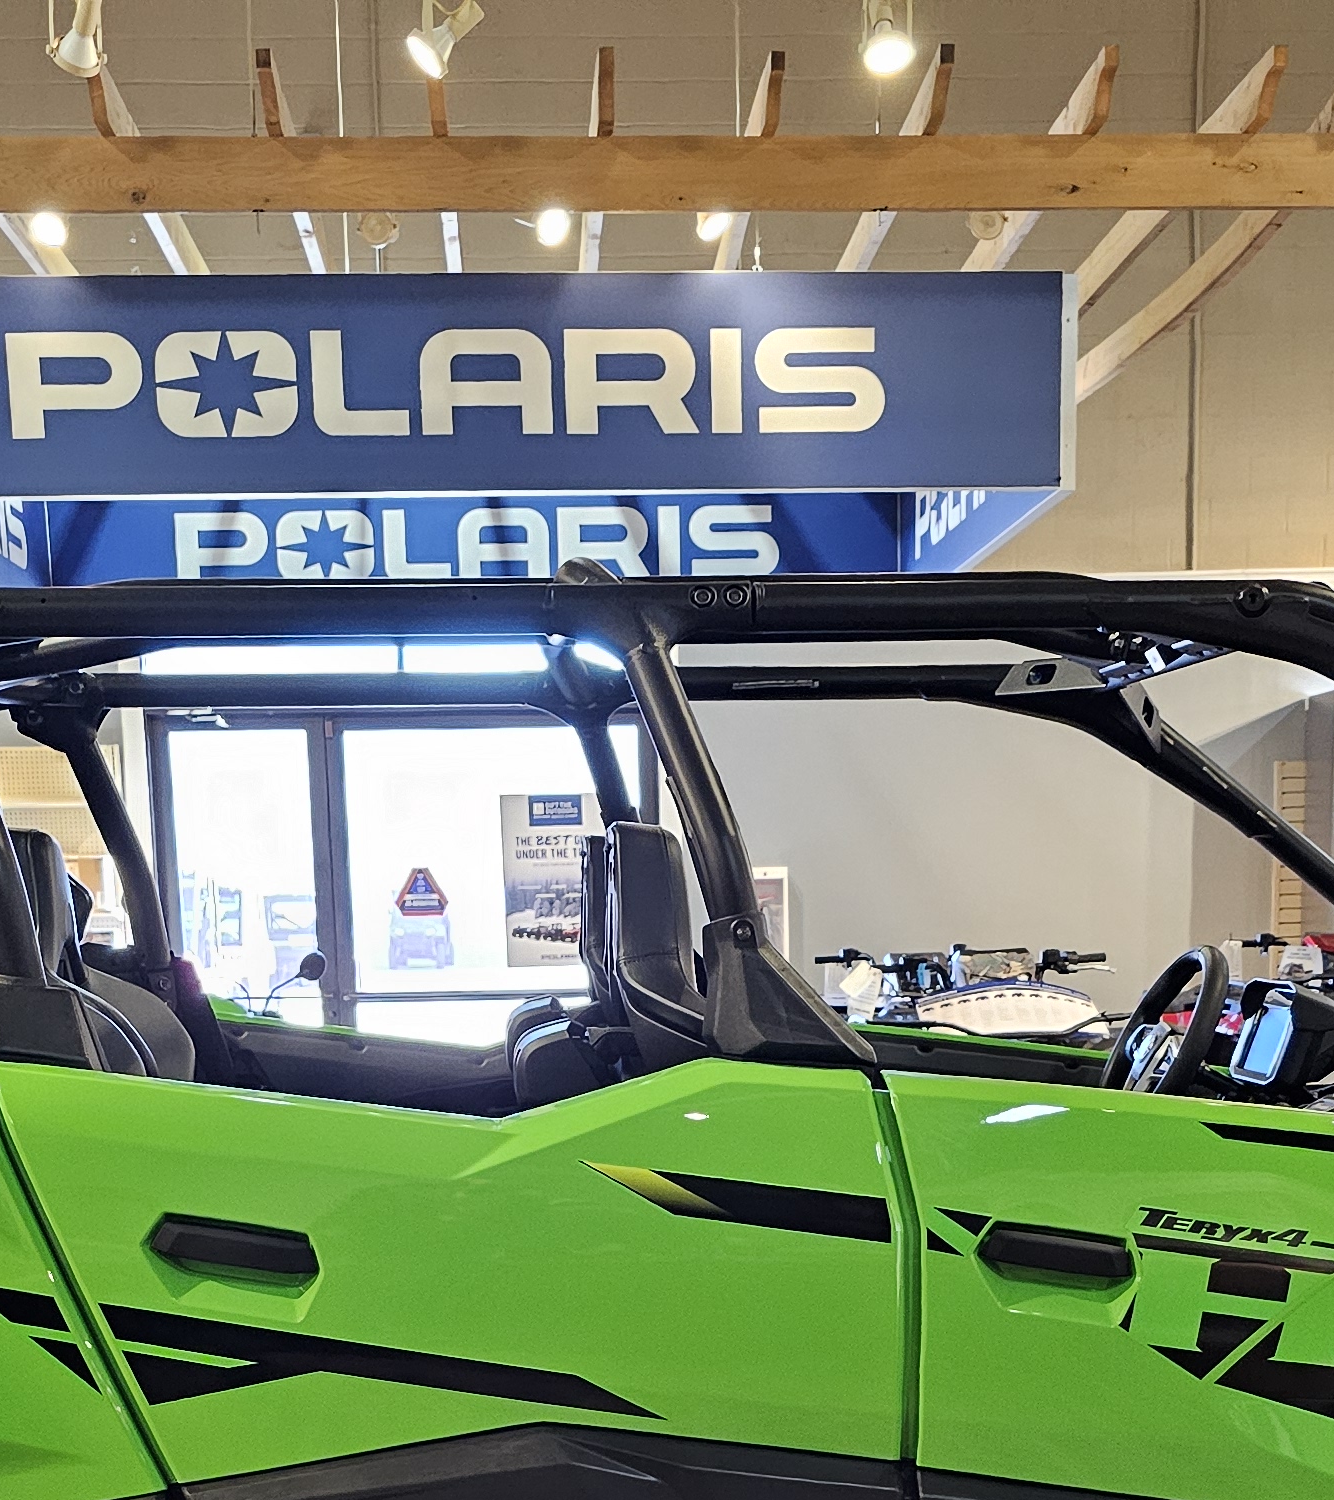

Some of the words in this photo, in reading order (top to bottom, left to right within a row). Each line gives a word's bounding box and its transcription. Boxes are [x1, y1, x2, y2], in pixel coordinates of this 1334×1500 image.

[5, 327, 886, 440] POLARIS
[173, 503, 780, 579] POLARIS
[516, 836, 532, 847] THE
[516, 849, 547, 860] UNDER
[550, 848, 569, 859] THE
